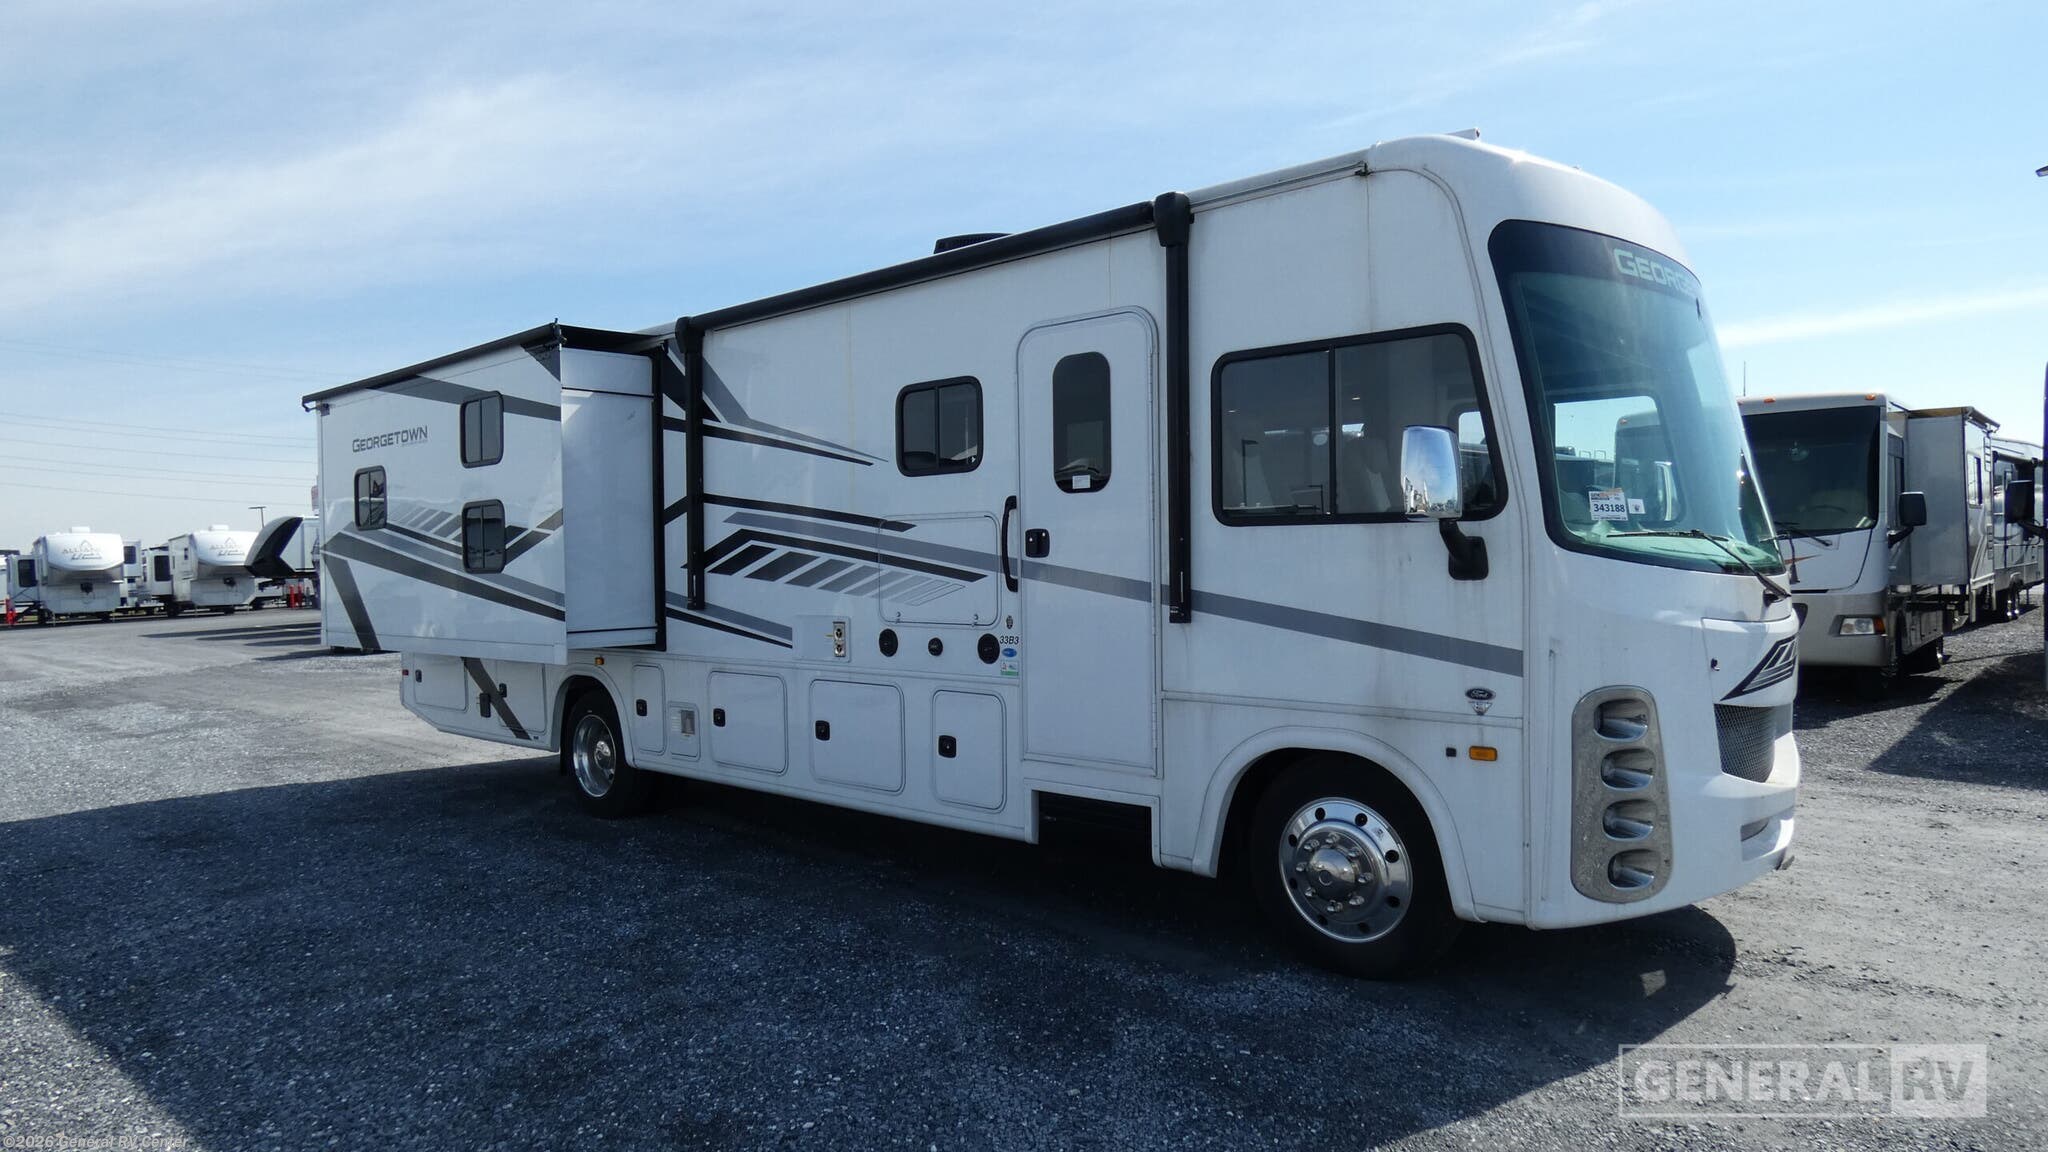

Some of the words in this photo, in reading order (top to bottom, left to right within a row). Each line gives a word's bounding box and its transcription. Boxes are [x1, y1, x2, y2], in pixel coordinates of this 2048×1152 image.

[352, 425, 428, 452] GEORGETOWN
[1593, 503, 1626, 513] 343188
[1000, 635, 1019, 645] 33B3
